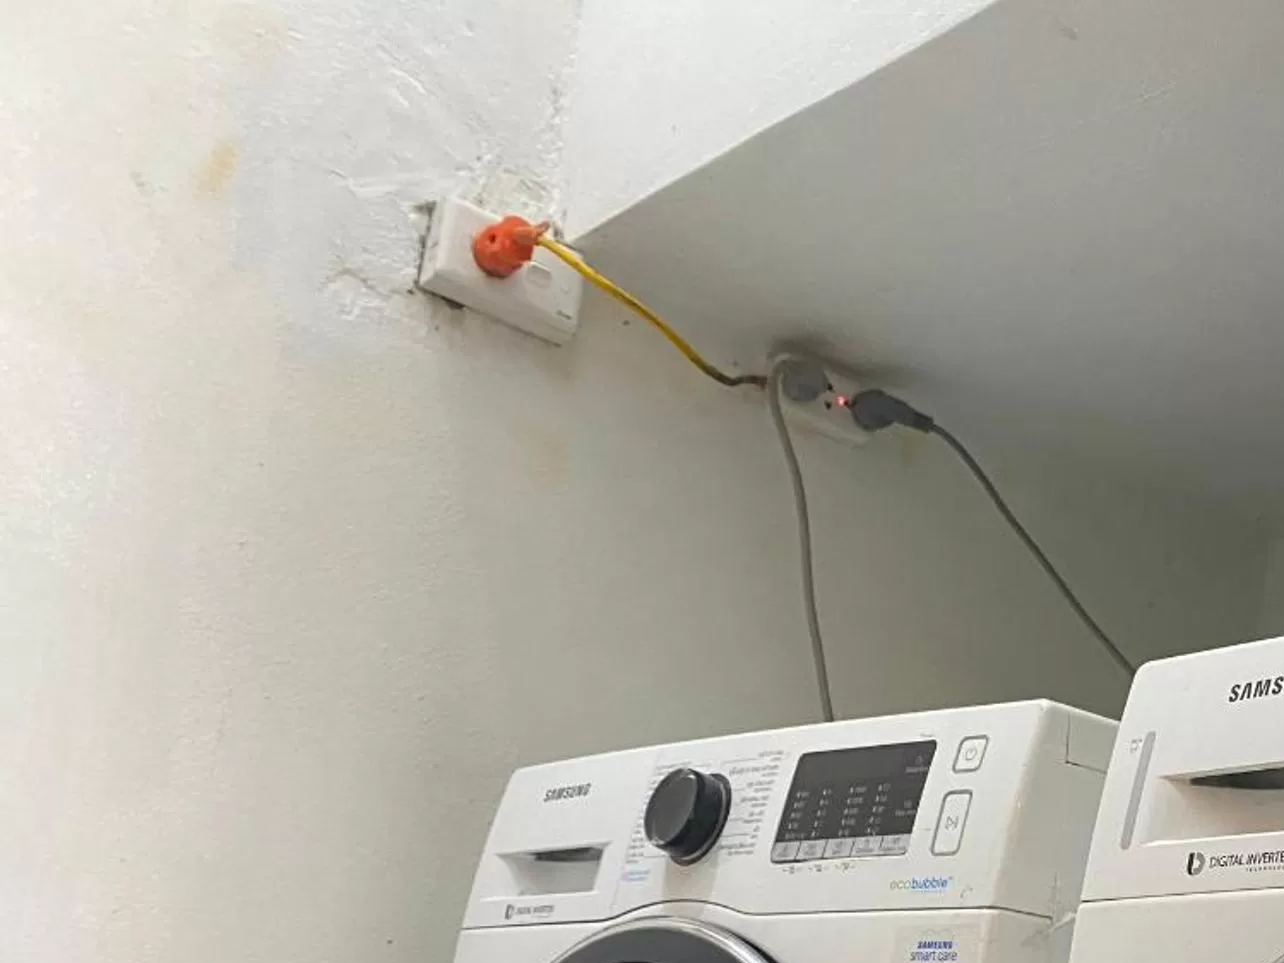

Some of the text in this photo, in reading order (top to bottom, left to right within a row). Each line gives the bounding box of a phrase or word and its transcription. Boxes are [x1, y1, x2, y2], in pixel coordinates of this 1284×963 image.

[543, 783, 592, 803] SAMSUNG
[1209, 853, 1246, 869] DIGITAL
[917, 941, 953, 950] SAMSUNG
[910, 951, 958, 962] smart care
